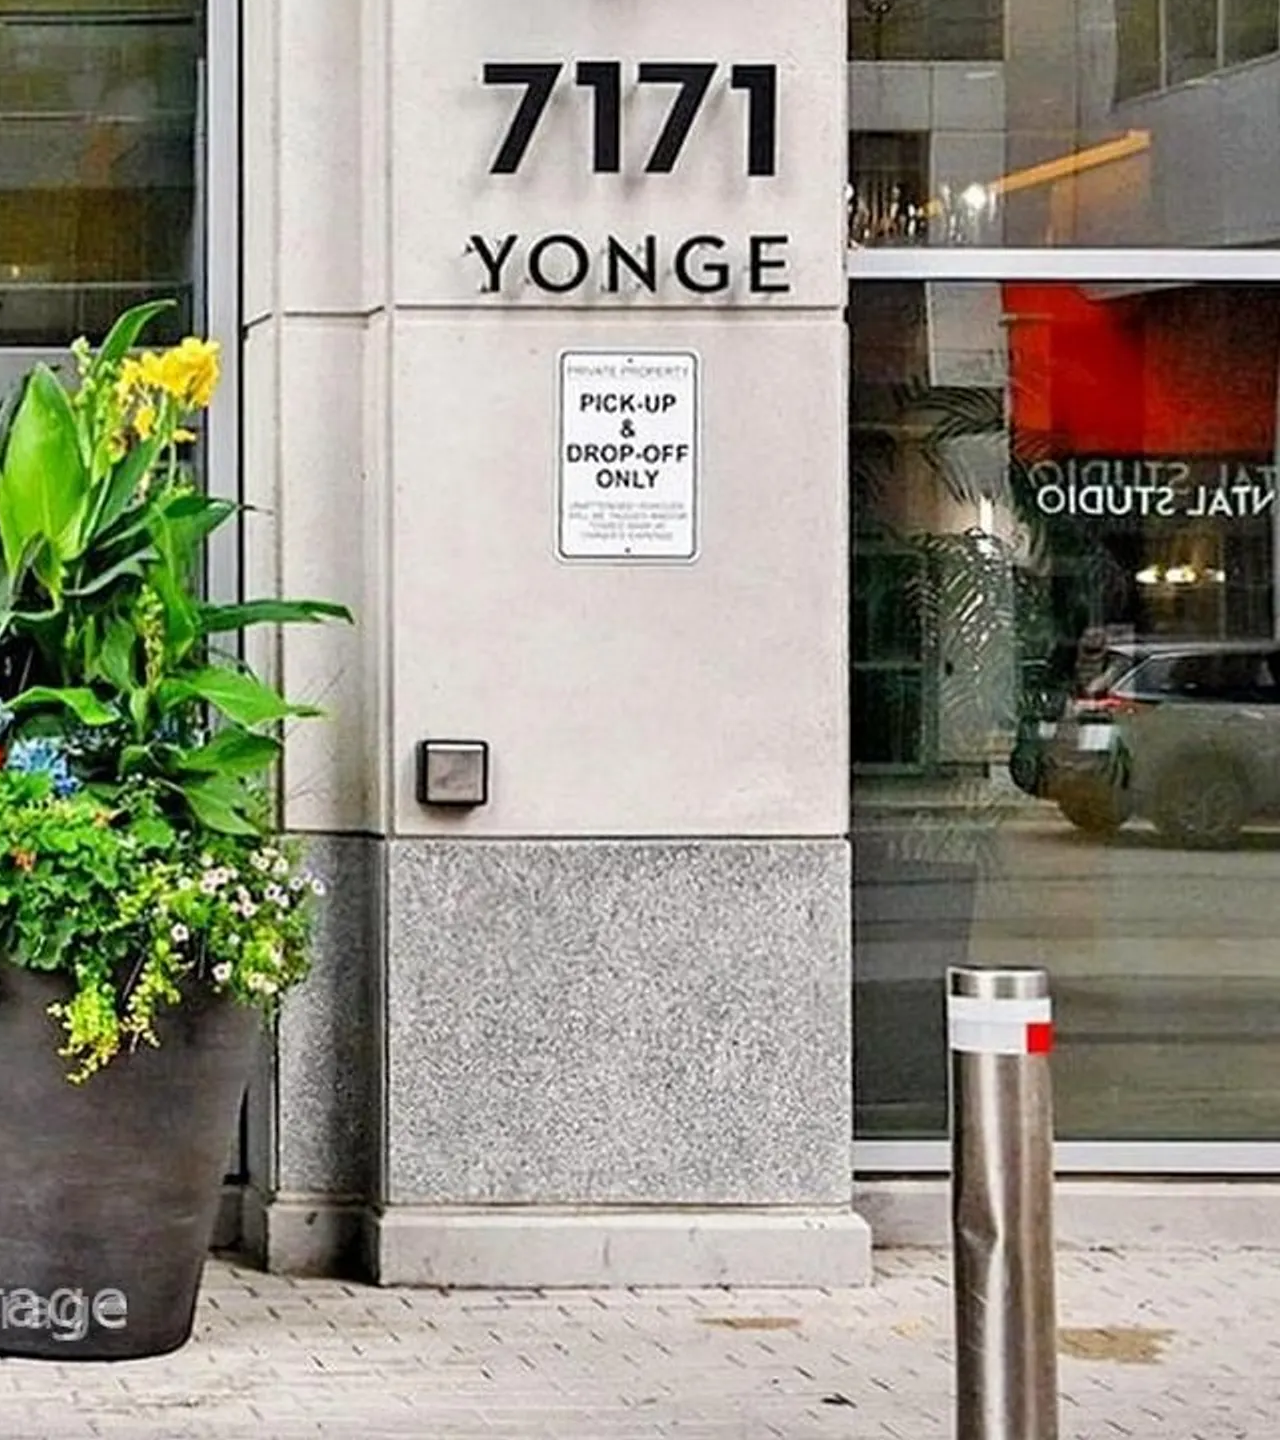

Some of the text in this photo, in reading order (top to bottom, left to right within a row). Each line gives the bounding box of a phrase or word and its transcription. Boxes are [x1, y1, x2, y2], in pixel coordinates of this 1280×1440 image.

[483, 60, 777, 176] 7171
[469, 234, 790, 293] YONGE
[579, 393, 678, 413] PICK-UP
[619, 418, 636, 439] &
[566, 443, 690, 464] DROP-OFF
[595, 468, 660, 489] ONLY
